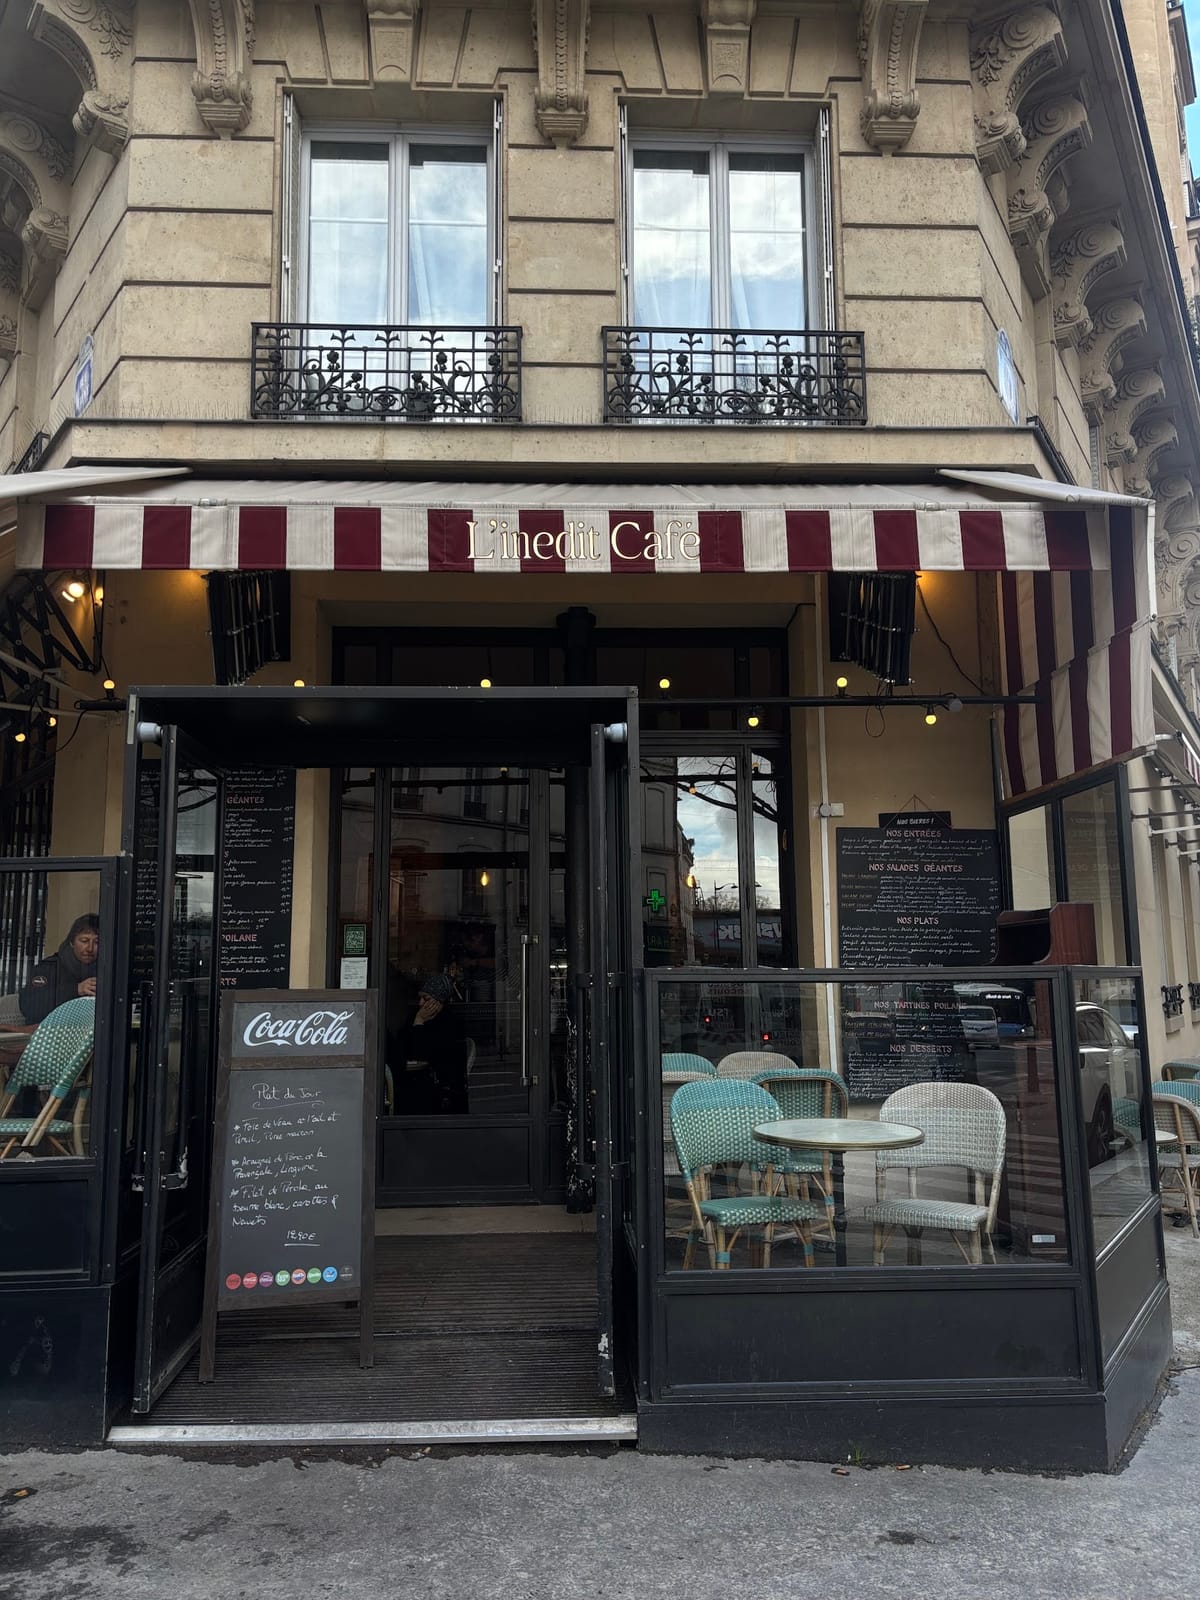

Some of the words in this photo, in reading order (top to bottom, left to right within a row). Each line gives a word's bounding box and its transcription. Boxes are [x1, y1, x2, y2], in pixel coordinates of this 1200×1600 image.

[611, 519, 701, 561] Café
[886, 829, 902, 838] NOS
[903, 828, 942, 838] ENTRÉES
[868, 863, 884, 872] NOS
[886, 863, 920, 872] SALADES
[923, 862, 964, 873] GÉANTES
[896, 917, 912, 925] NOS
[913, 917, 940, 925] PLATS
[873, 1001, 890, 1010] NOS
[893, 1001, 931, 1010] TARTINES
[244, 1010, 354, 1047] Coca-Cola
[889, 1044, 906, 1053] NOS
[909, 1044, 953, 1054] DESSERTS
[252, 1082, 281, 1101] Plat
[283, 1087, 297, 1100] du
[298, 1087, 322, 1100] Jour
[314, 1183, 329, 1191] au
